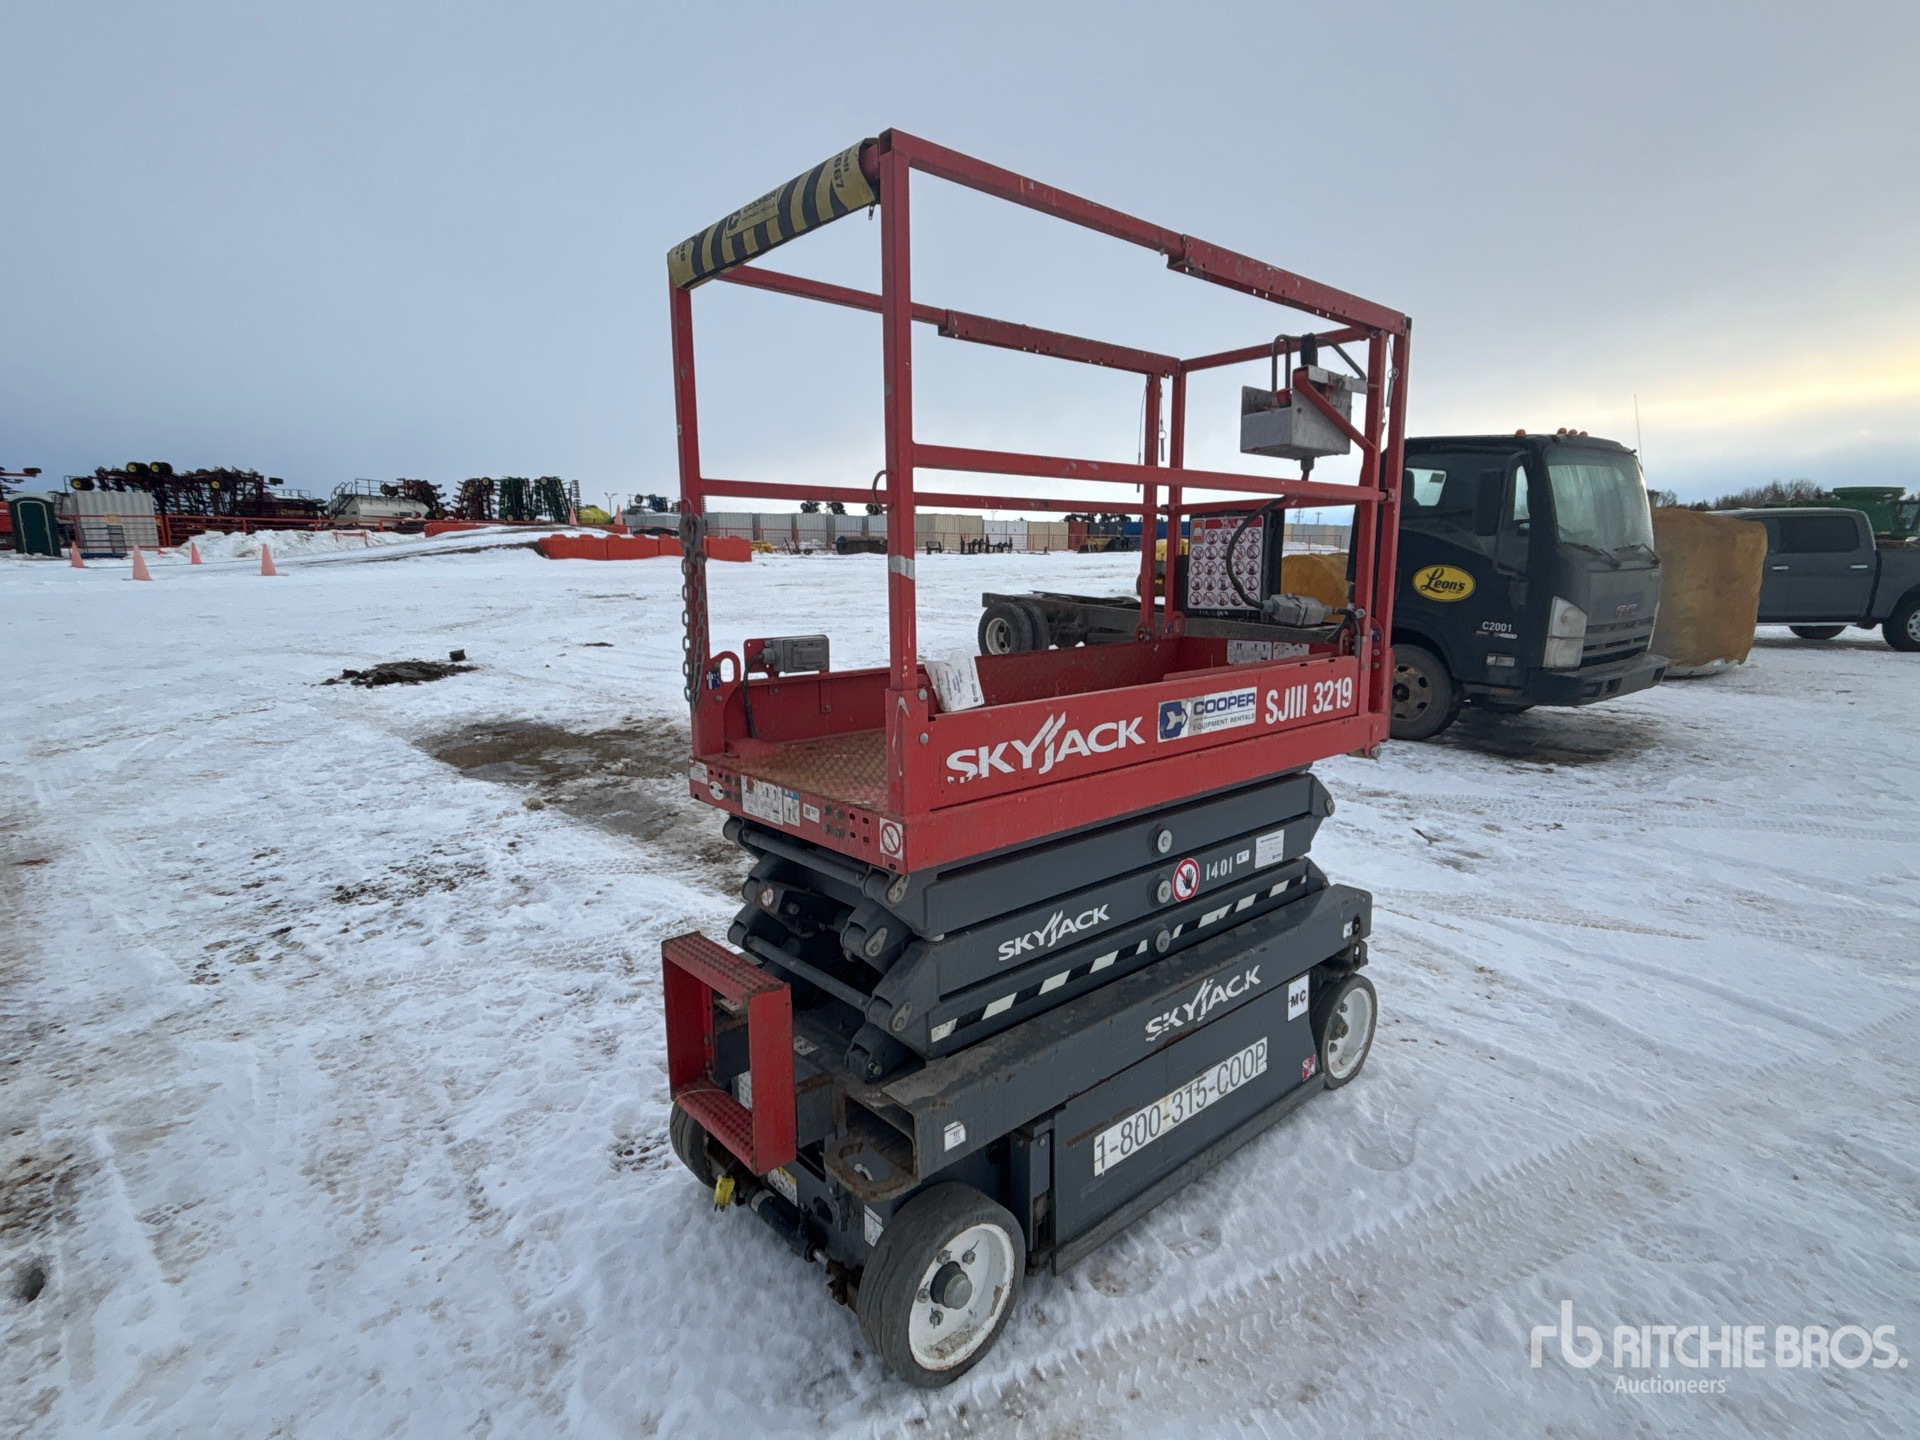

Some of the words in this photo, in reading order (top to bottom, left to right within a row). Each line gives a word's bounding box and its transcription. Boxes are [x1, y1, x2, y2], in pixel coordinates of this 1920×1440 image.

[1482, 621, 1512, 632] C2001
[1193, 693, 1256, 716] COOPER
[1265, 684, 1308, 725] SJIII
[1312, 677, 1353, 714] 3219
[1192, 718, 1228, 731] EQUIPMENT
[1230, 713, 1255, 723] RENTALS
[946, 711, 1146, 784] SKYJACK
[1206, 856, 1233, 881] 1401
[998, 903, 1110, 961] SKYJACK
[1145, 965, 1261, 1041] SKYJACK
[1290, 989, 1307, 1008] MC
[1096, 1042, 1265, 1169] 1-800-315-COOP
